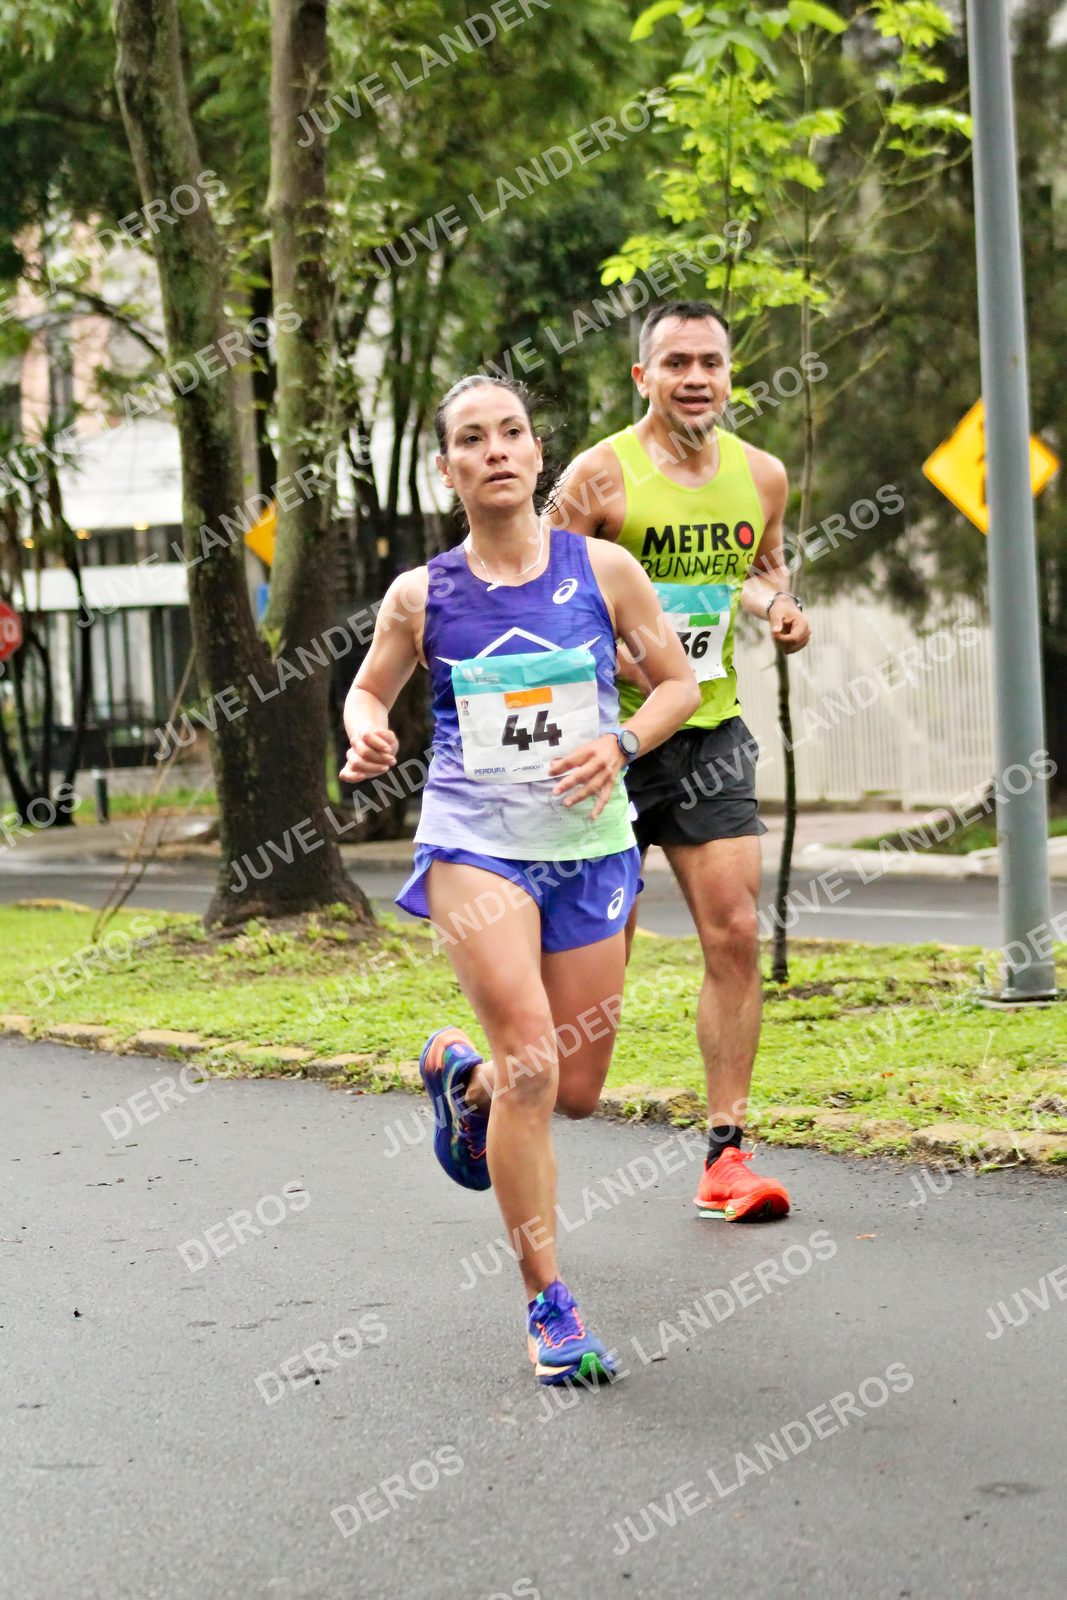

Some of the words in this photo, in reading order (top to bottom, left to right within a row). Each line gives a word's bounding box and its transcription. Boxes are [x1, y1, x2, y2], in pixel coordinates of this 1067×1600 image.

[641, 521, 755, 557] METRO
[502, 710, 563, 751] 44
[474, 767, 506, 775] PERDURA
